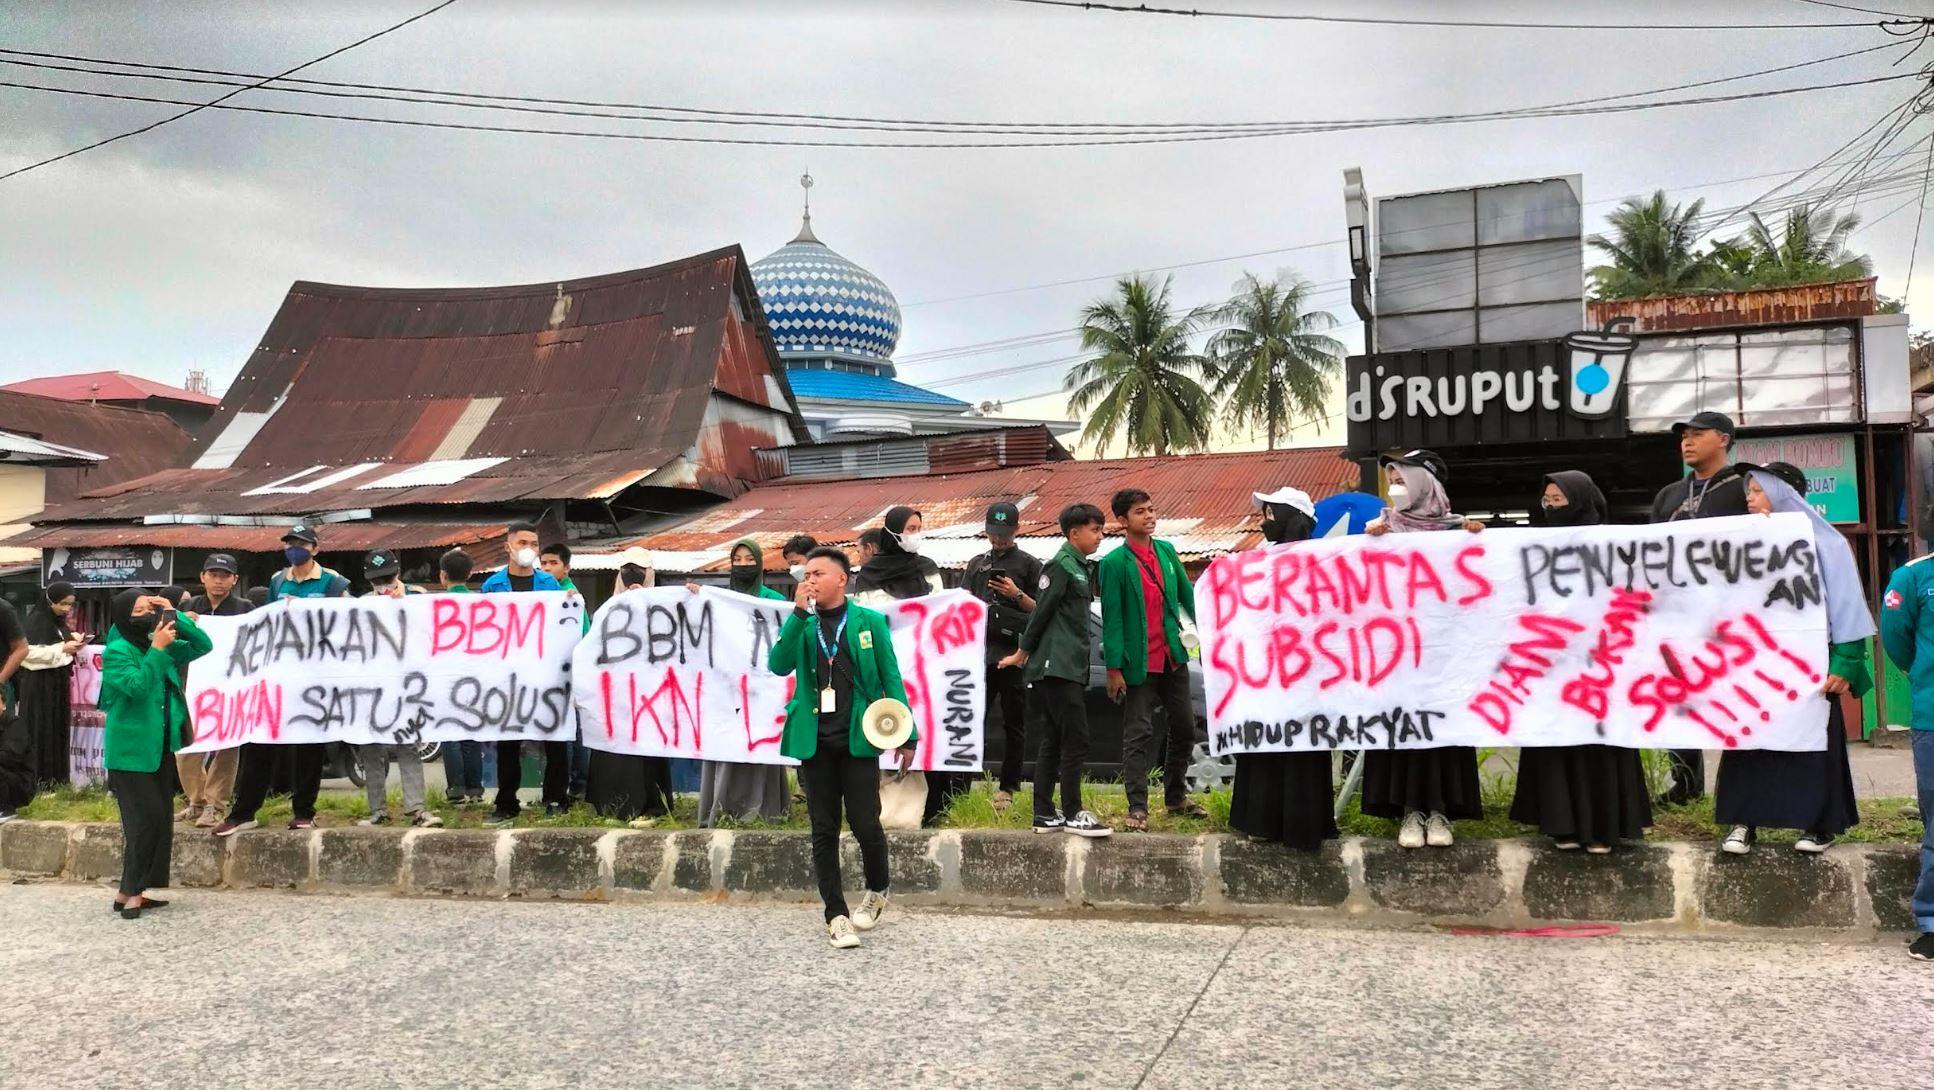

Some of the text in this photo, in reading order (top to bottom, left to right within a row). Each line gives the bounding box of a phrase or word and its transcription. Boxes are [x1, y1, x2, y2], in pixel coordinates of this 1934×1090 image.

[73, 559, 144, 570] SERBUNI HIJAB
[1208, 546, 1493, 631] BERANTAS
[431, 598, 546, 660] BBM
[596, 600, 714, 669] BBM
[1210, 616, 1421, 719] SUBSIDI
[1469, 614, 1586, 735] DIAM
[192, 680, 283, 742] BUKAN
[601, 667, 701, 751] IKN
[943, 669, 978, 767] NURANI
[1310, 707, 1446, 748] RAKYAT
